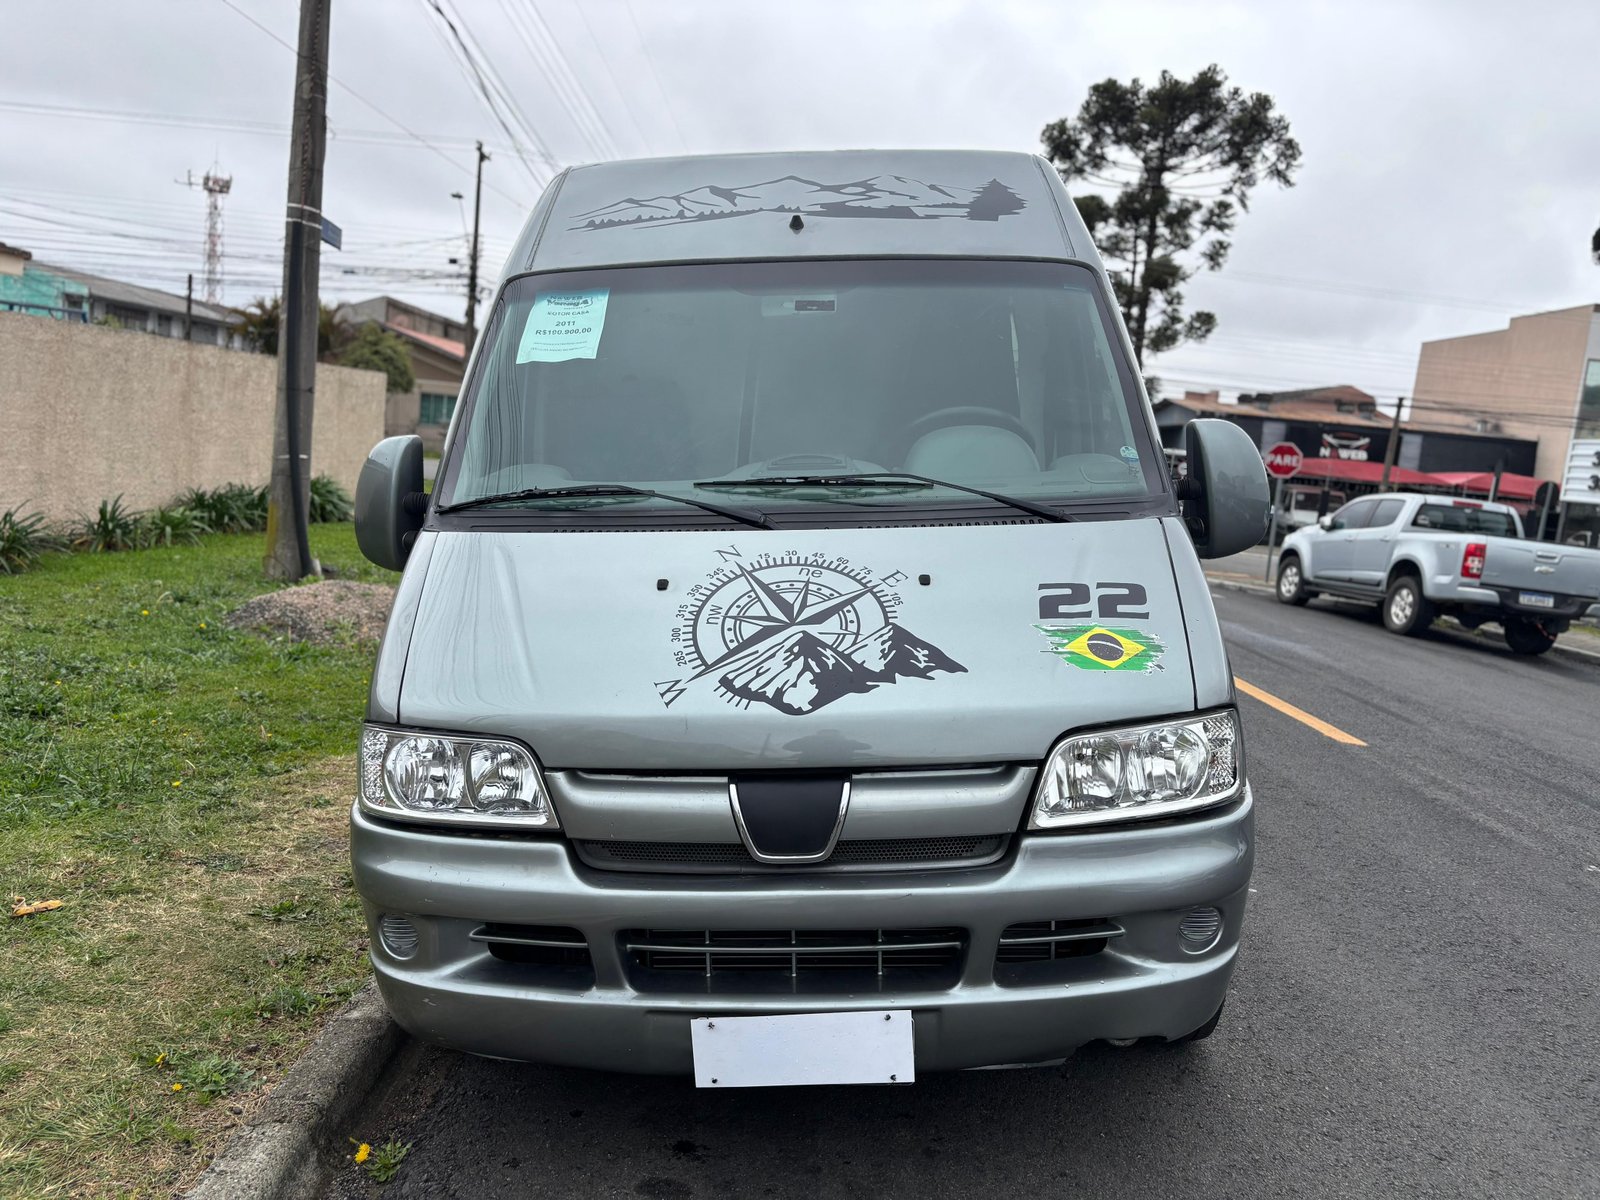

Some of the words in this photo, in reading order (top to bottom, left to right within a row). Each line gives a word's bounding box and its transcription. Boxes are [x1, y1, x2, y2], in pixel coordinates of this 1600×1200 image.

[1264, 453, 1300, 467] PARE
[713, 544, 742, 563] N
[758, 552, 771, 560] 15
[812, 552, 826, 560] 45
[836, 556, 849, 565] 60
[706, 567, 725, 580] 345
[798, 567, 823, 578] ne
[860, 565, 873, 576] 75
[879, 568, 909, 588] E
[890, 591, 904, 606] 105
[1038, 581, 1150, 620] 22
[675, 604, 689, 619] 315
[706, 604, 723, 625] nw
[671, 627, 682, 643] 300
[673, 650, 688, 667] 285
